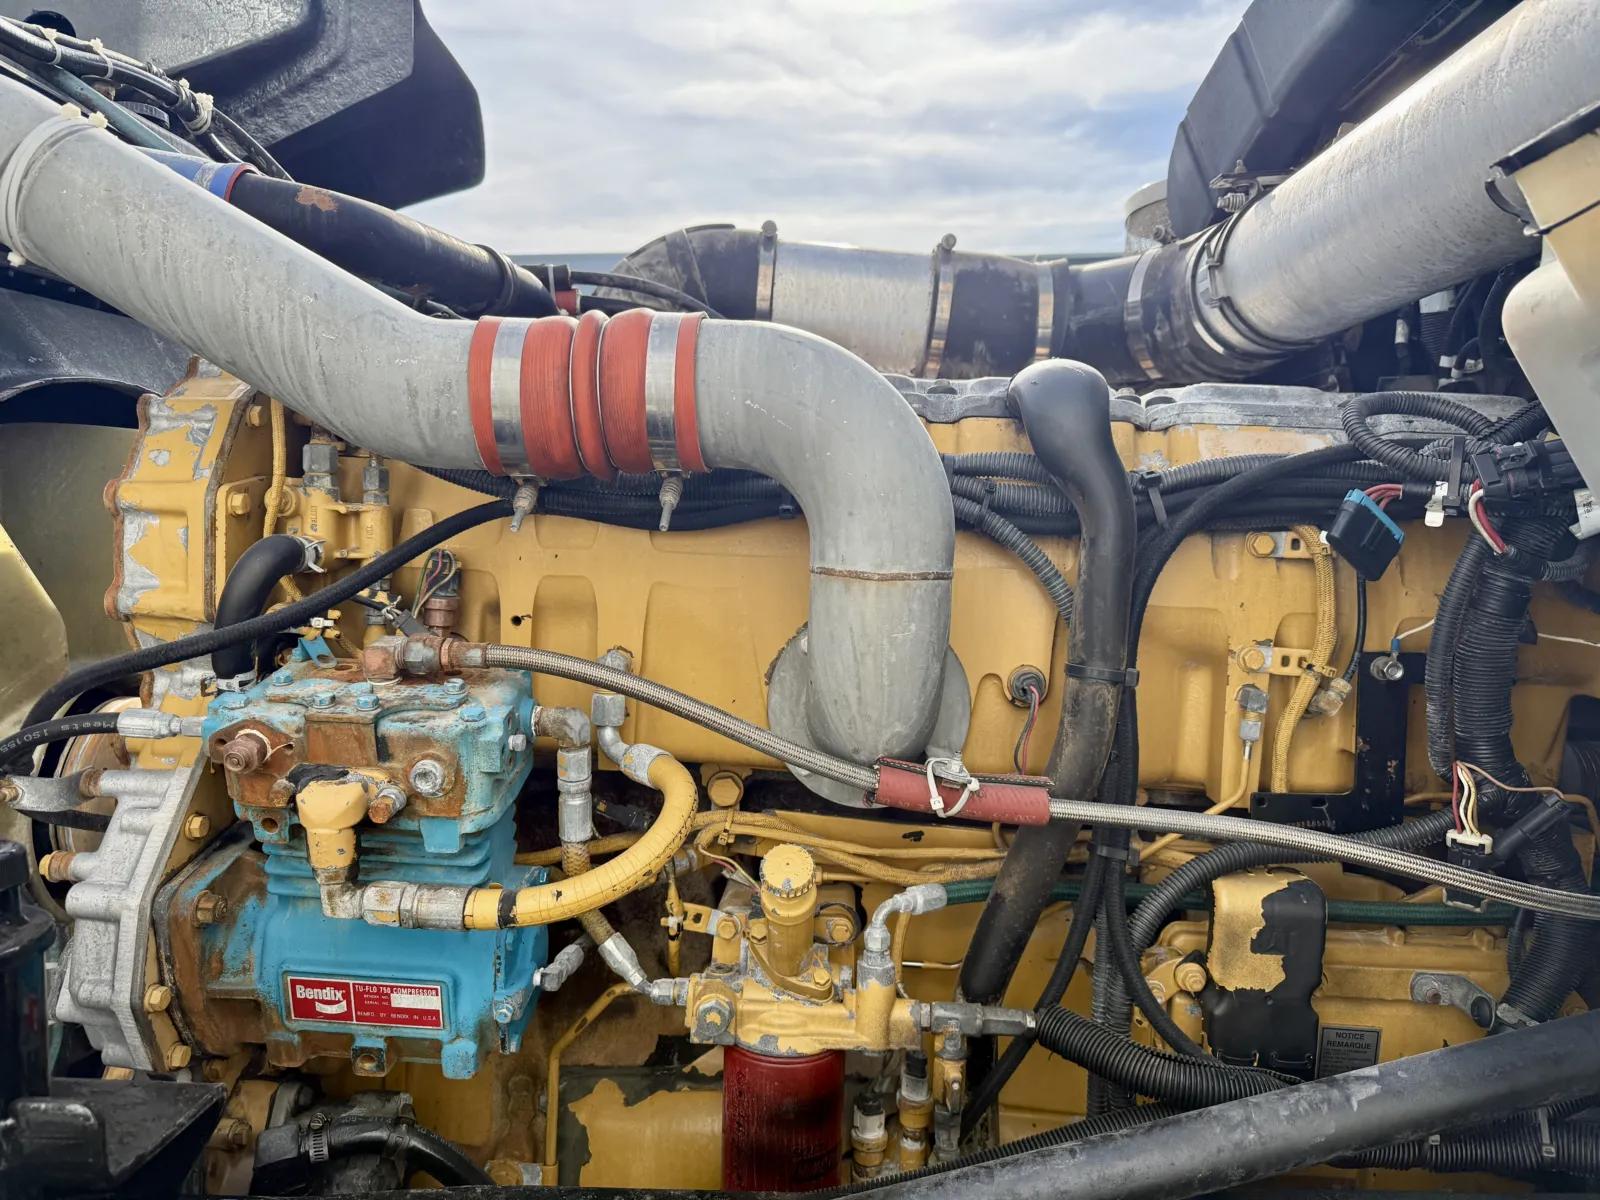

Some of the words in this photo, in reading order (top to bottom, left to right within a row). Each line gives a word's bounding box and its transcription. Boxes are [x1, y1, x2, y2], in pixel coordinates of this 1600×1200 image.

[295, 984, 345, 1001] Bendix
[354, 984, 378, 993] TU-FLO
[392, 988, 437, 997] COMPRESSOR
[1335, 1031, 1365, 1040] NOTICE
[1326, 1040, 1372, 1050] REMARQUE
